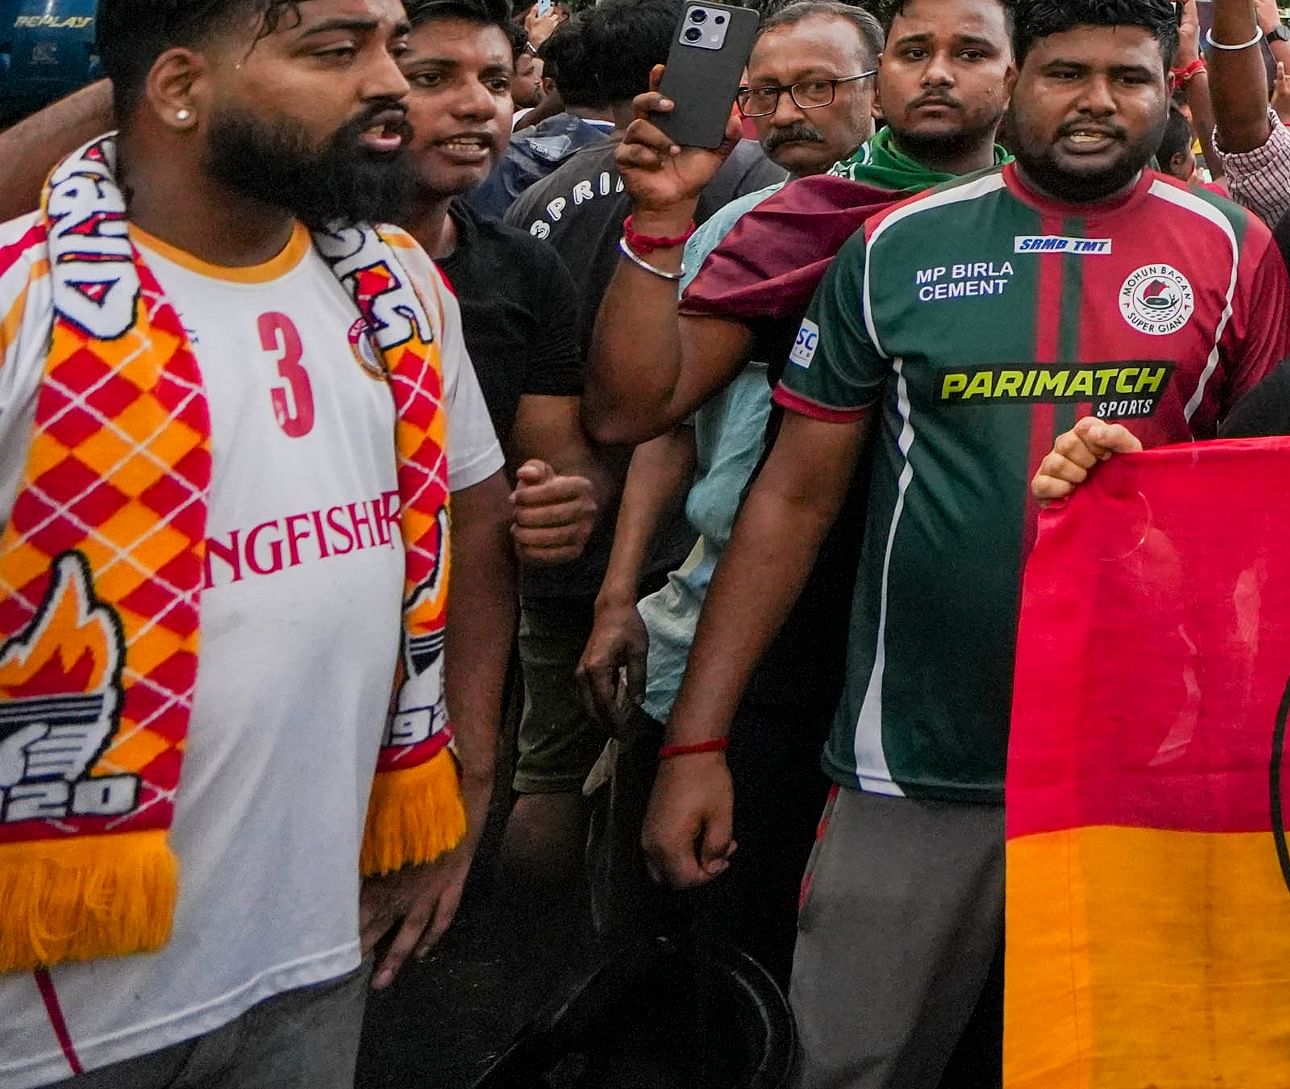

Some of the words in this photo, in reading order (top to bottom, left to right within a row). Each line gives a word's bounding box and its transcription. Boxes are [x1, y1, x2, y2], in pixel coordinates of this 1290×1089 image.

[529, 171, 625, 241] SPRI
[1019, 238, 1068, 251] SRMB
[1073, 240, 1109, 252] TMT
[915, 265, 946, 285] MP
[951, 260, 1014, 280] BIRLA
[1123, 266, 1157, 297] MOHUN
[1160, 266, 1192, 300] BAGAN
[918, 279, 1009, 302] CEMENT
[1127, 312, 1156, 333] SUPER
[1157, 314, 1186, 333] GIANT
[256, 311, 316, 438] 3
[940, 367, 1167, 401] PARIMATCH
[1096, 399, 1154, 418] SPORTS
